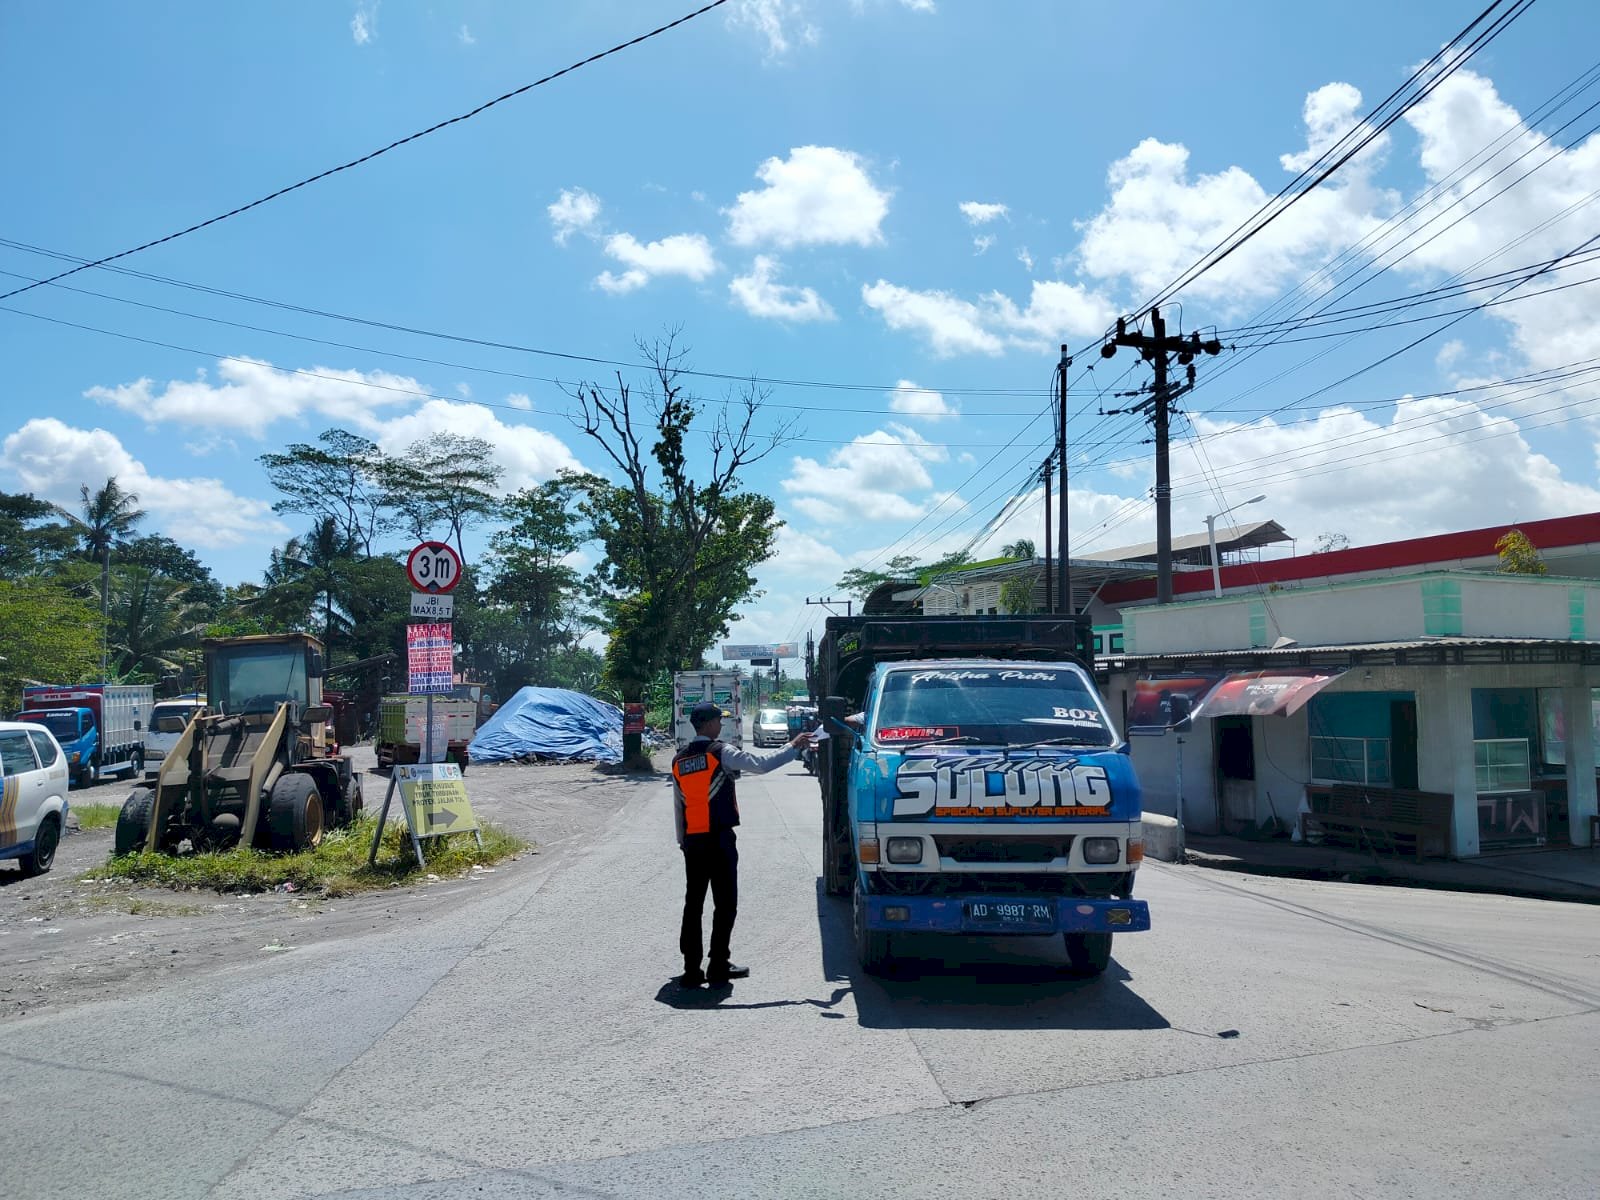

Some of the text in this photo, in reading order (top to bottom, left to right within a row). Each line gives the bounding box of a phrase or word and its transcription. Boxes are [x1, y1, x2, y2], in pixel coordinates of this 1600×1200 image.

[425, 596, 439, 605] JBI
[409, 624, 450, 632] TERAPI
[998, 670, 1057, 681] Putri
[410, 684, 451, 692] DIJAMIN
[1052, 706, 1099, 722] BOY
[933, 755, 1079, 774] Putri
[893, 758, 1112, 816] SULUNG
[973, 903, 1050, 919] AD 9987 RM
